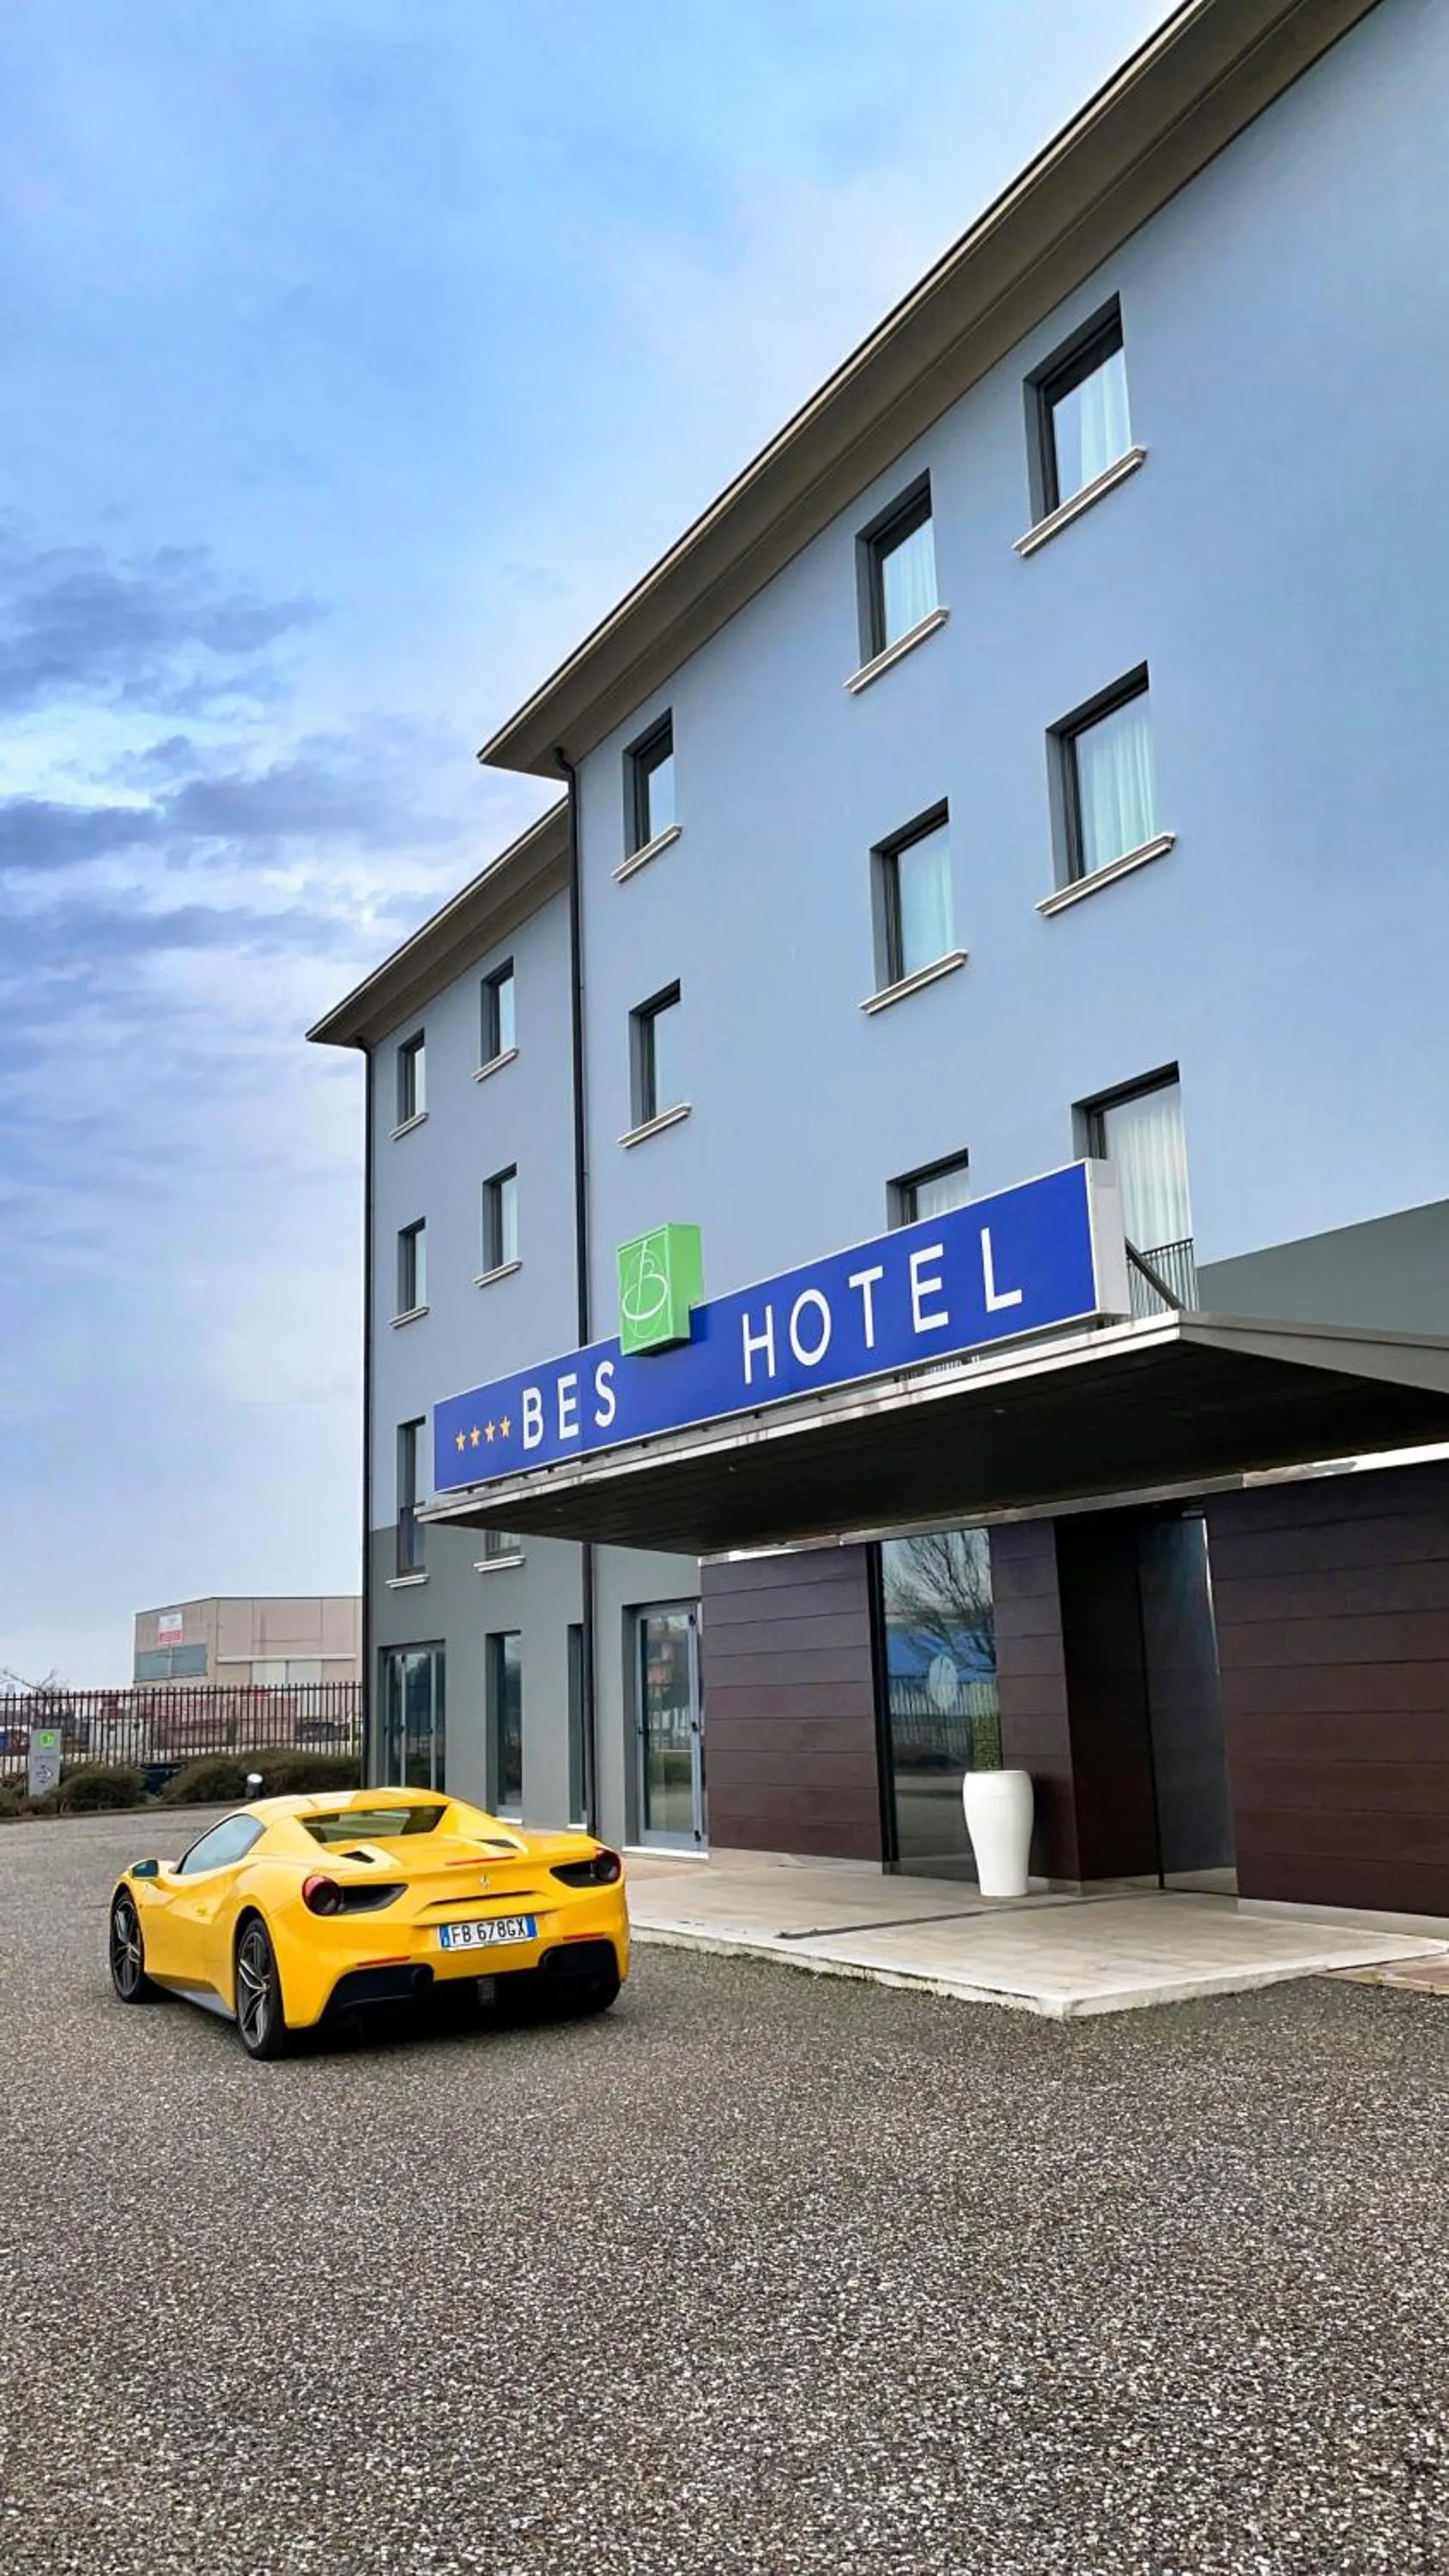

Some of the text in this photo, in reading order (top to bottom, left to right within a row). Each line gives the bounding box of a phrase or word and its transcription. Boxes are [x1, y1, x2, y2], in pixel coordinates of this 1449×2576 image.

[522, 1227, 1022, 1450] BES HOTEL
[452, 1918, 525, 1944] FB 678GX
